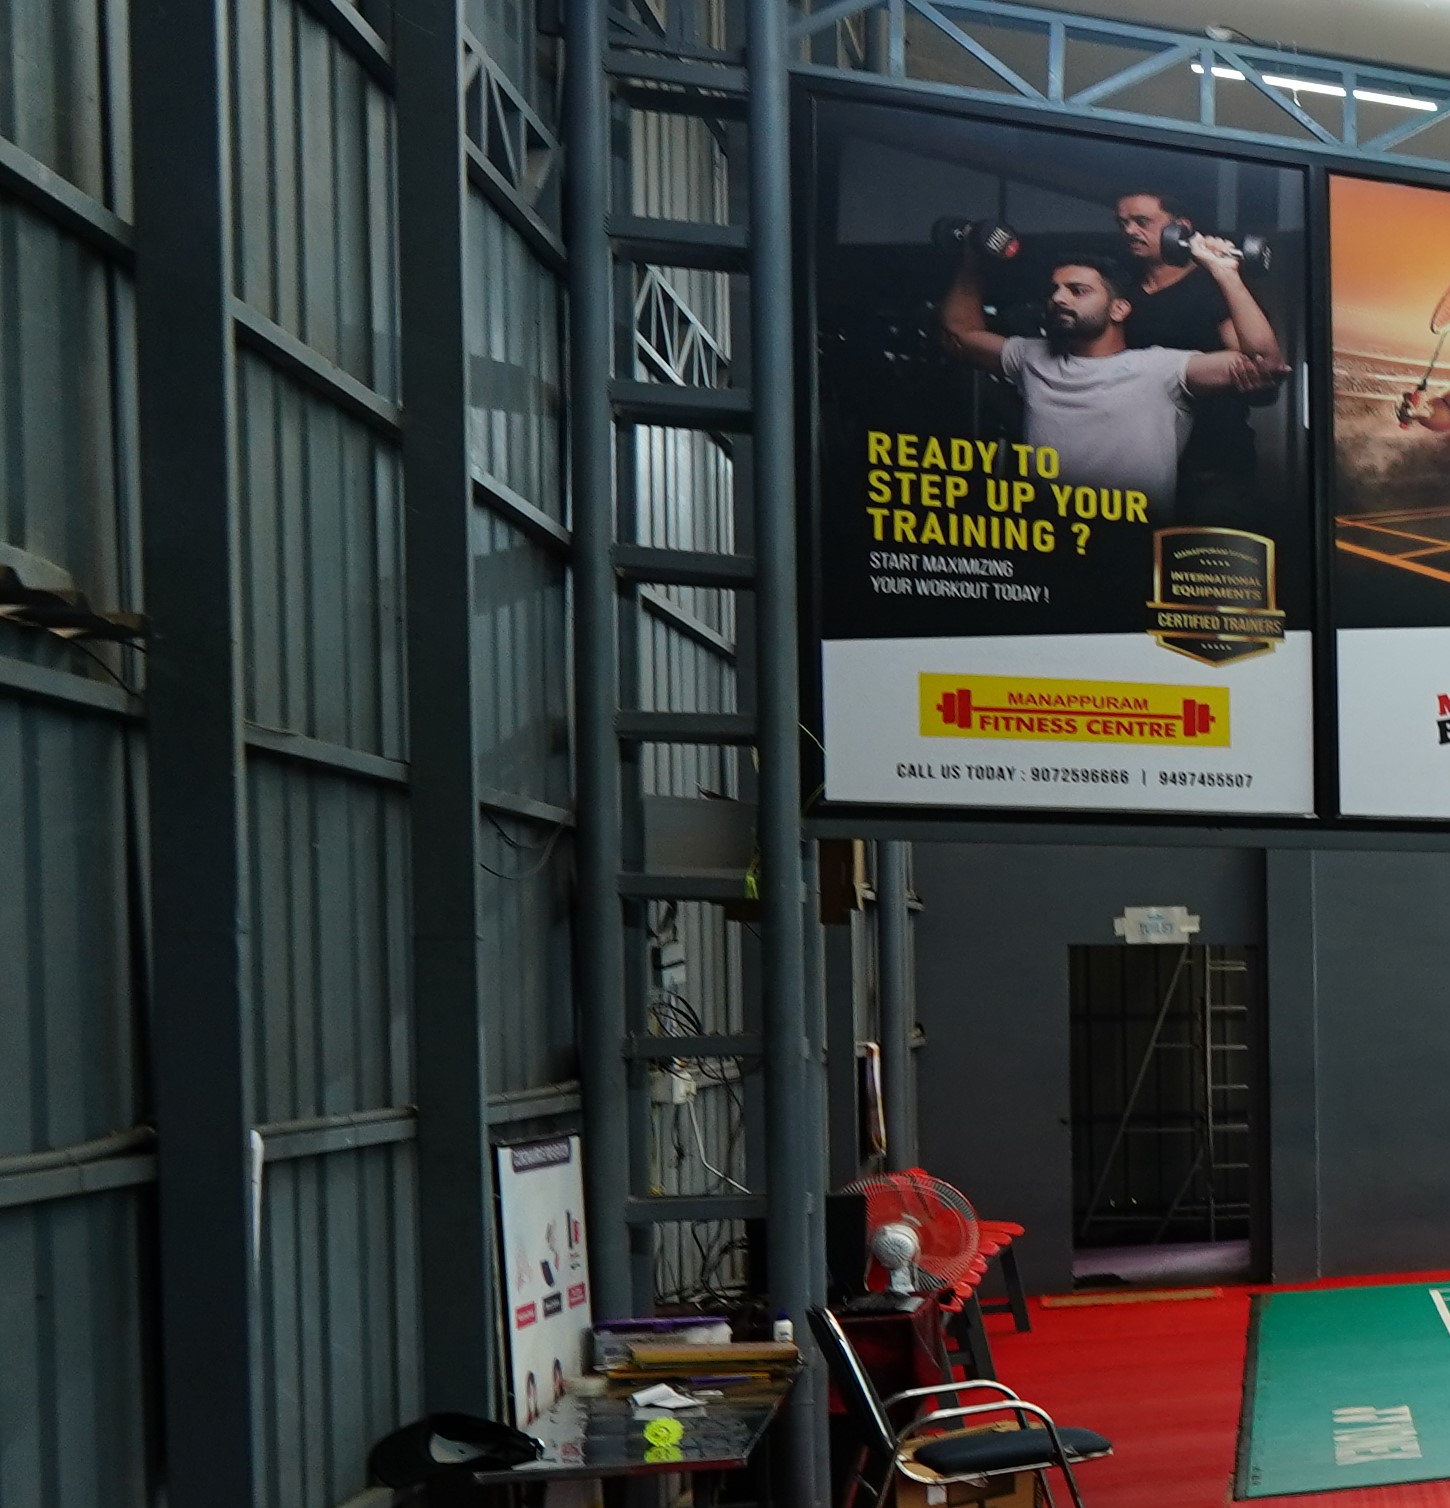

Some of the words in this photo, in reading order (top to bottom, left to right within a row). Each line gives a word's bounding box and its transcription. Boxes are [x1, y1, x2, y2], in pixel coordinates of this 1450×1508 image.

[868, 431, 998, 474] READY
[1011, 443, 1059, 479] TO
[868, 469, 968, 509] STEP
[986, 477, 1035, 513] UP
[1050, 483, 1149, 523] YOUR
[866, 507, 1055, 553] TRAINING
[870, 552, 920, 572] START
[922, 555, 1013, 578] MAXIMIZING
[870, 575, 911, 595] YOUR
[915, 579, 990, 600] WORKOUT
[993, 583, 1040, 603] TODAY
[1171, 570, 1262, 587] INTERNATIONAL
[1172, 584, 1262, 600] EQUIPMENTS
[1158, 612, 1219, 630] CERTIFIED
[1223, 616, 1282, 633] TRAINERS
[1008, 692, 1148, 711] MANAPPURAM
[979, 715, 1078, 734] FITNESS
[1087, 720, 1176, 738] CENTRE
[896, 763, 937, 779] CALL
[940, 765, 961, 780] US
[966, 766, 1016, 782] TODAY
[1030, 767, 1129, 784] 9072596666
[1158, 770, 1253, 788] 9497455507
